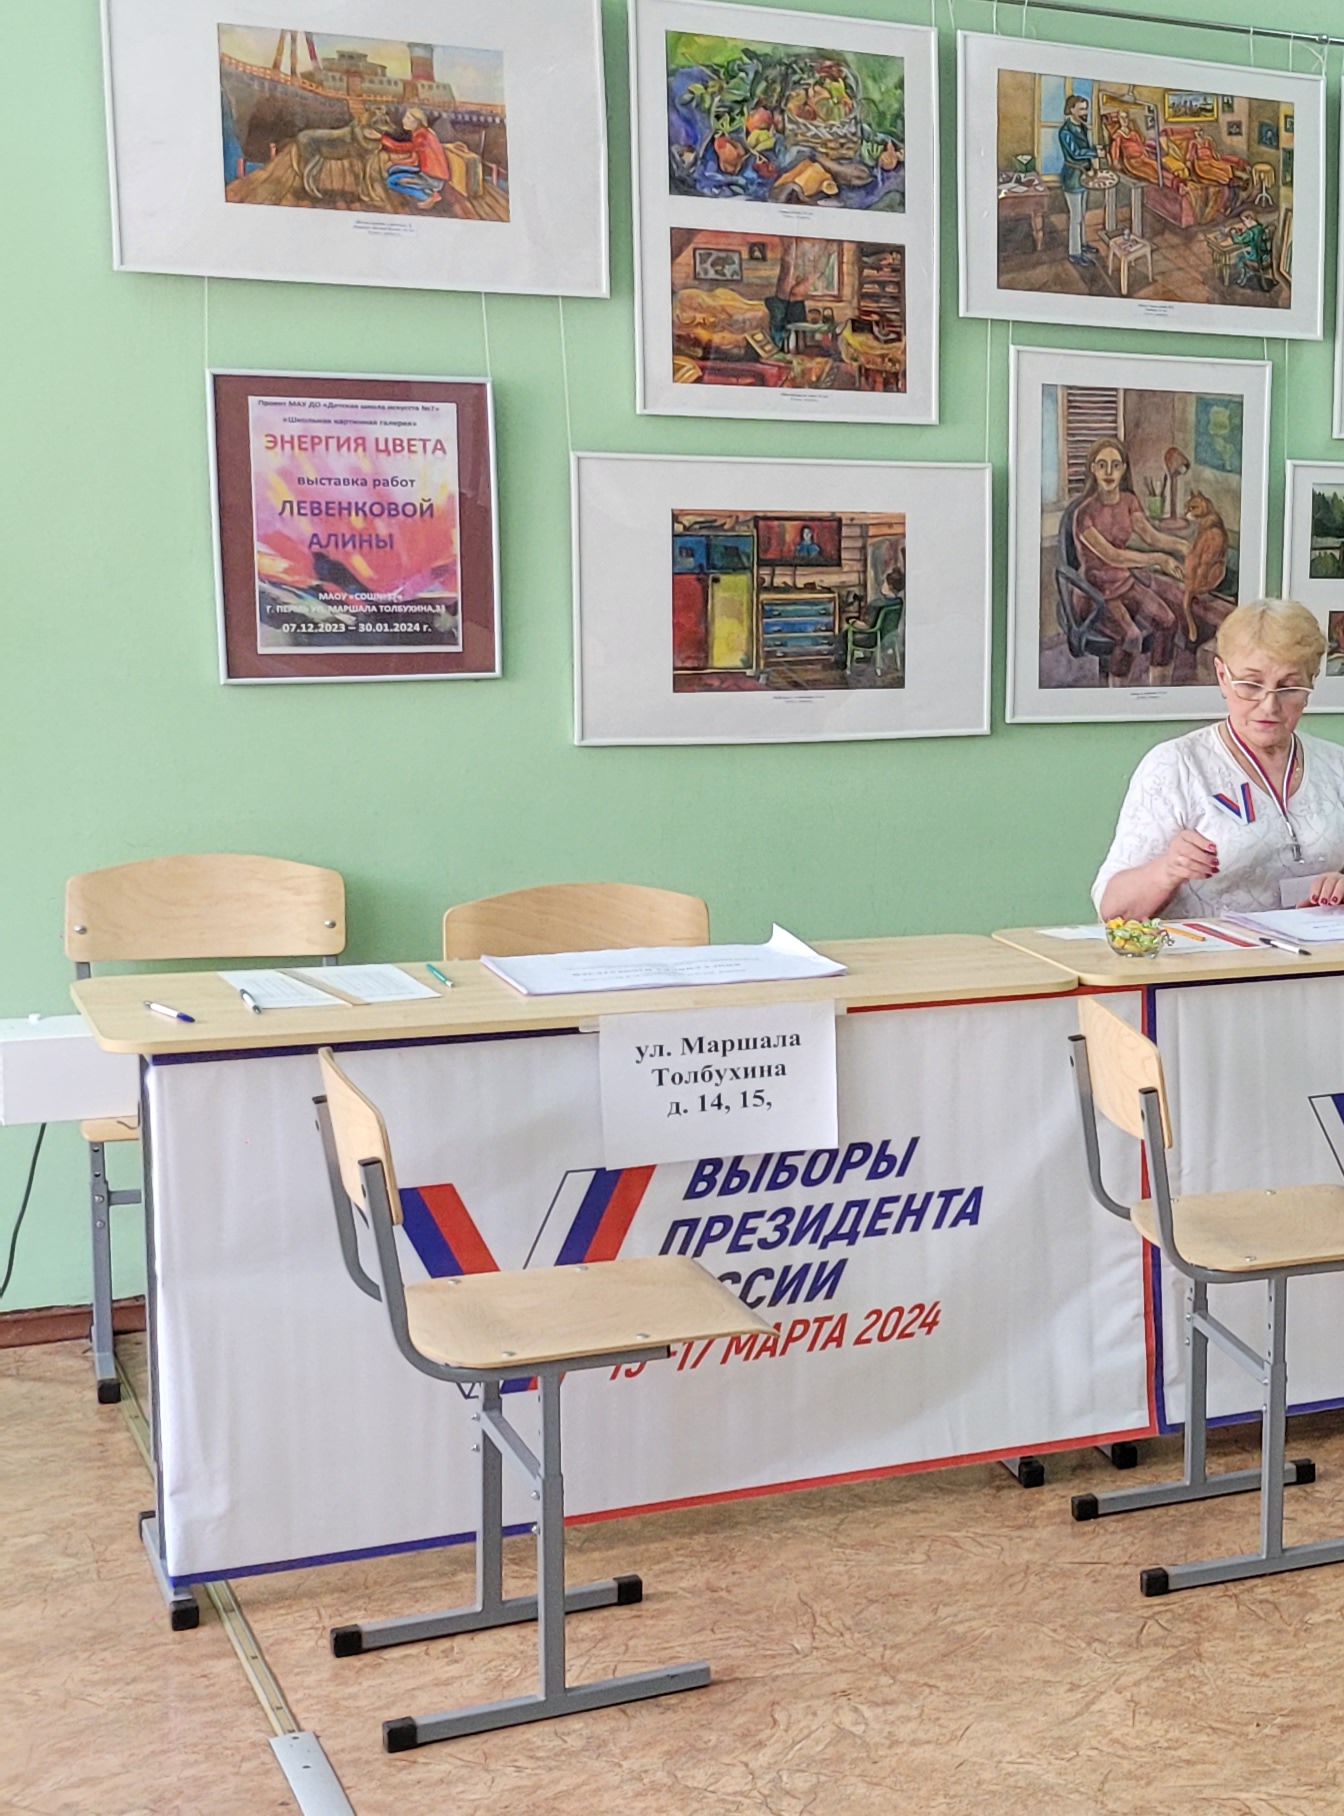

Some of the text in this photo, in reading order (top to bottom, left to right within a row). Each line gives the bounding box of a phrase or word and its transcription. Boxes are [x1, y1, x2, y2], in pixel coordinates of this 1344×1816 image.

[288, 400, 307, 408] МАУ
[308, 400, 321, 409] ДО
[264, 433, 447, 456] ЭНЕРГИЯ ЦВЕТА
[297, 475, 416, 489] выставка работ
[278, 497, 434, 519] ЛЕВЕНКОВОЙ
[308, 532, 394, 550] АЛИНЫ
[318, 592, 347, 601] МАОУ
[328, 604, 378, 614] МАРШАЛА
[282, 623, 345, 633] 07.12.2023
[358, 622, 421, 633] 30.01.2024
[635, 1032, 802, 1064] ул. Маршала
[651, 1062, 787, 1087] Толбухина
[667, 1088, 772, 1118] д. 14, 15,
[683, 1136, 920, 1201] ВЫБОРЫ
[658, 1185, 984, 1259] ПРЕЗИДЕНТА
[719, 1312, 848, 1365] МАРТА
[852, 1301, 942, 1346] 2024
